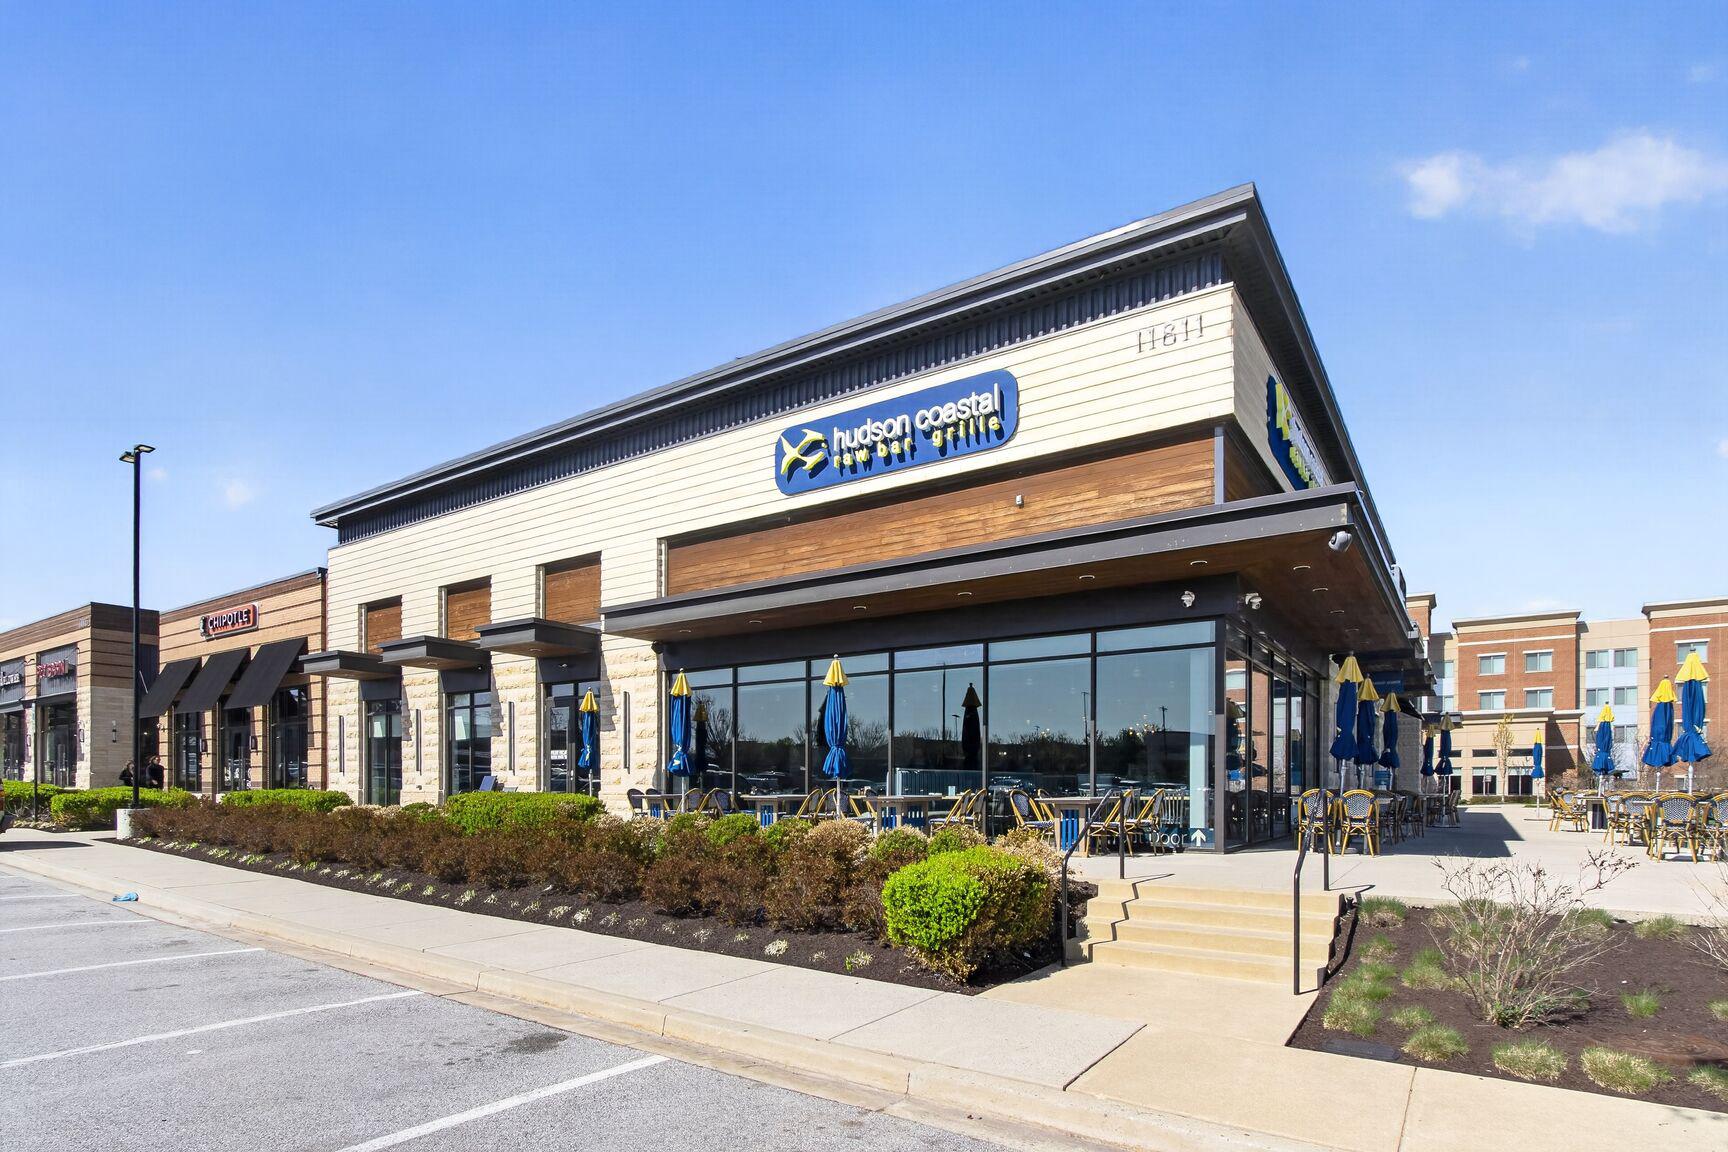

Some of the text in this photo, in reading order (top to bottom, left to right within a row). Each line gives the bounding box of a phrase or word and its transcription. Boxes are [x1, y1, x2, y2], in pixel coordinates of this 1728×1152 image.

[833, 383, 1001, 452] hudson coastal
[833, 415, 1001, 468] raw bar grille
[208, 609, 248, 629] CHIPOTLE
